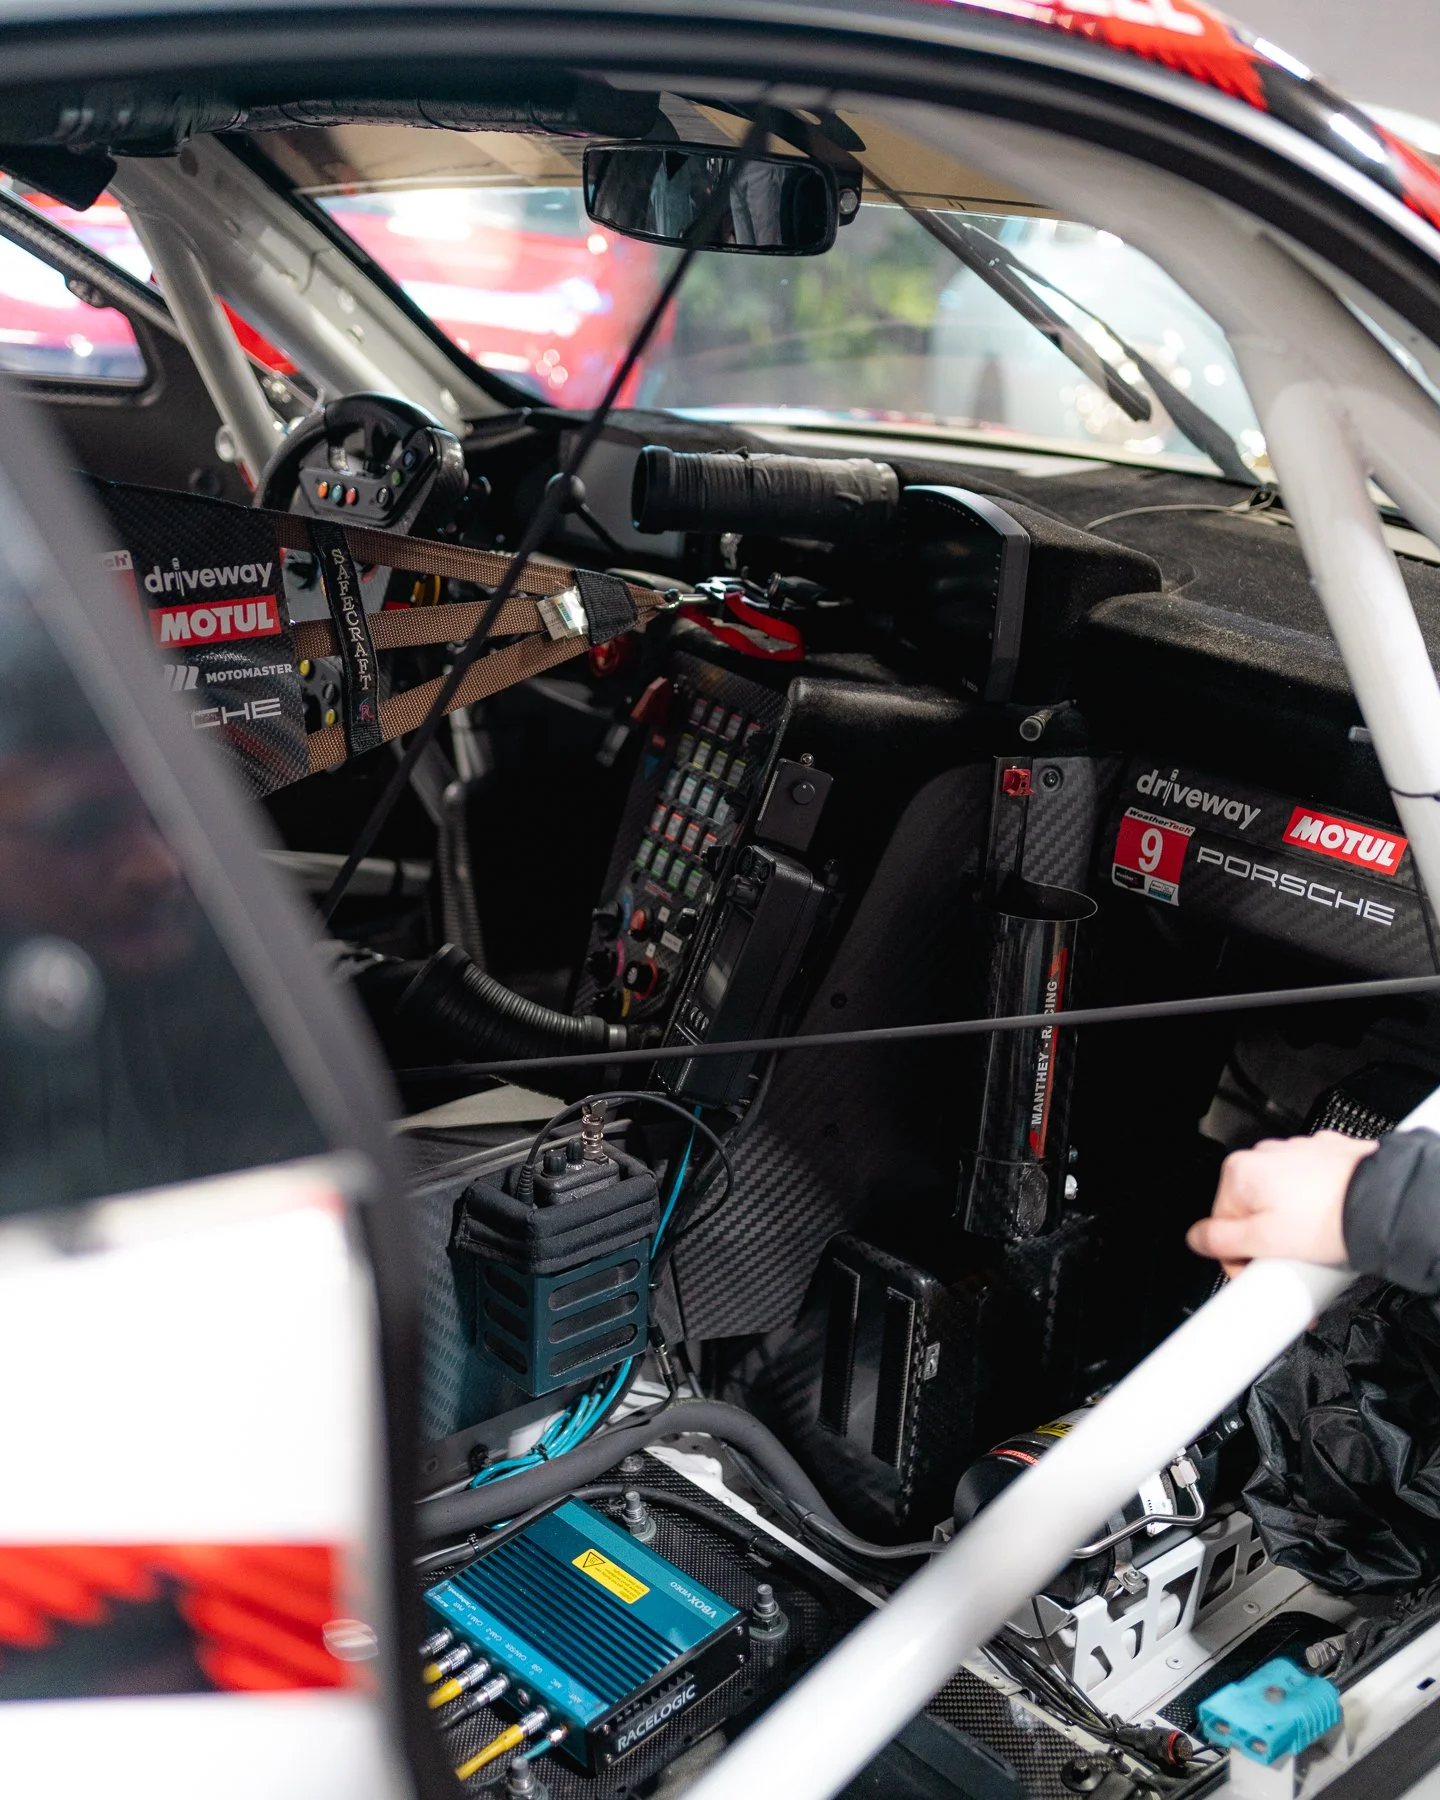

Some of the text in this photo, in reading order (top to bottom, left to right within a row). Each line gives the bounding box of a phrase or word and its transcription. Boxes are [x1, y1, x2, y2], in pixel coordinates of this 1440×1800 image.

[144, 557, 274, 597] driveway
[160, 602, 274, 642] MOTUL
[331, 548, 372, 691] SAFECRAFT
[205, 663, 293, 684] MOTOMASTER
[1128, 808, 1193, 834] WeatherTech
[1136, 768, 1262, 830] driveway
[1138, 828, 1164, 873] 9
[1289, 815, 1395, 867] MOTUL
[1197, 846, 1396, 926] PORSCHE
[1040, 981, 1058, 1039] RCING
[1031, 1052, 1050, 1126] MANTHEY
[670, 1581, 717, 1619] VBOX VIDEO
[617, 1684, 697, 1752] RACELOGIC
